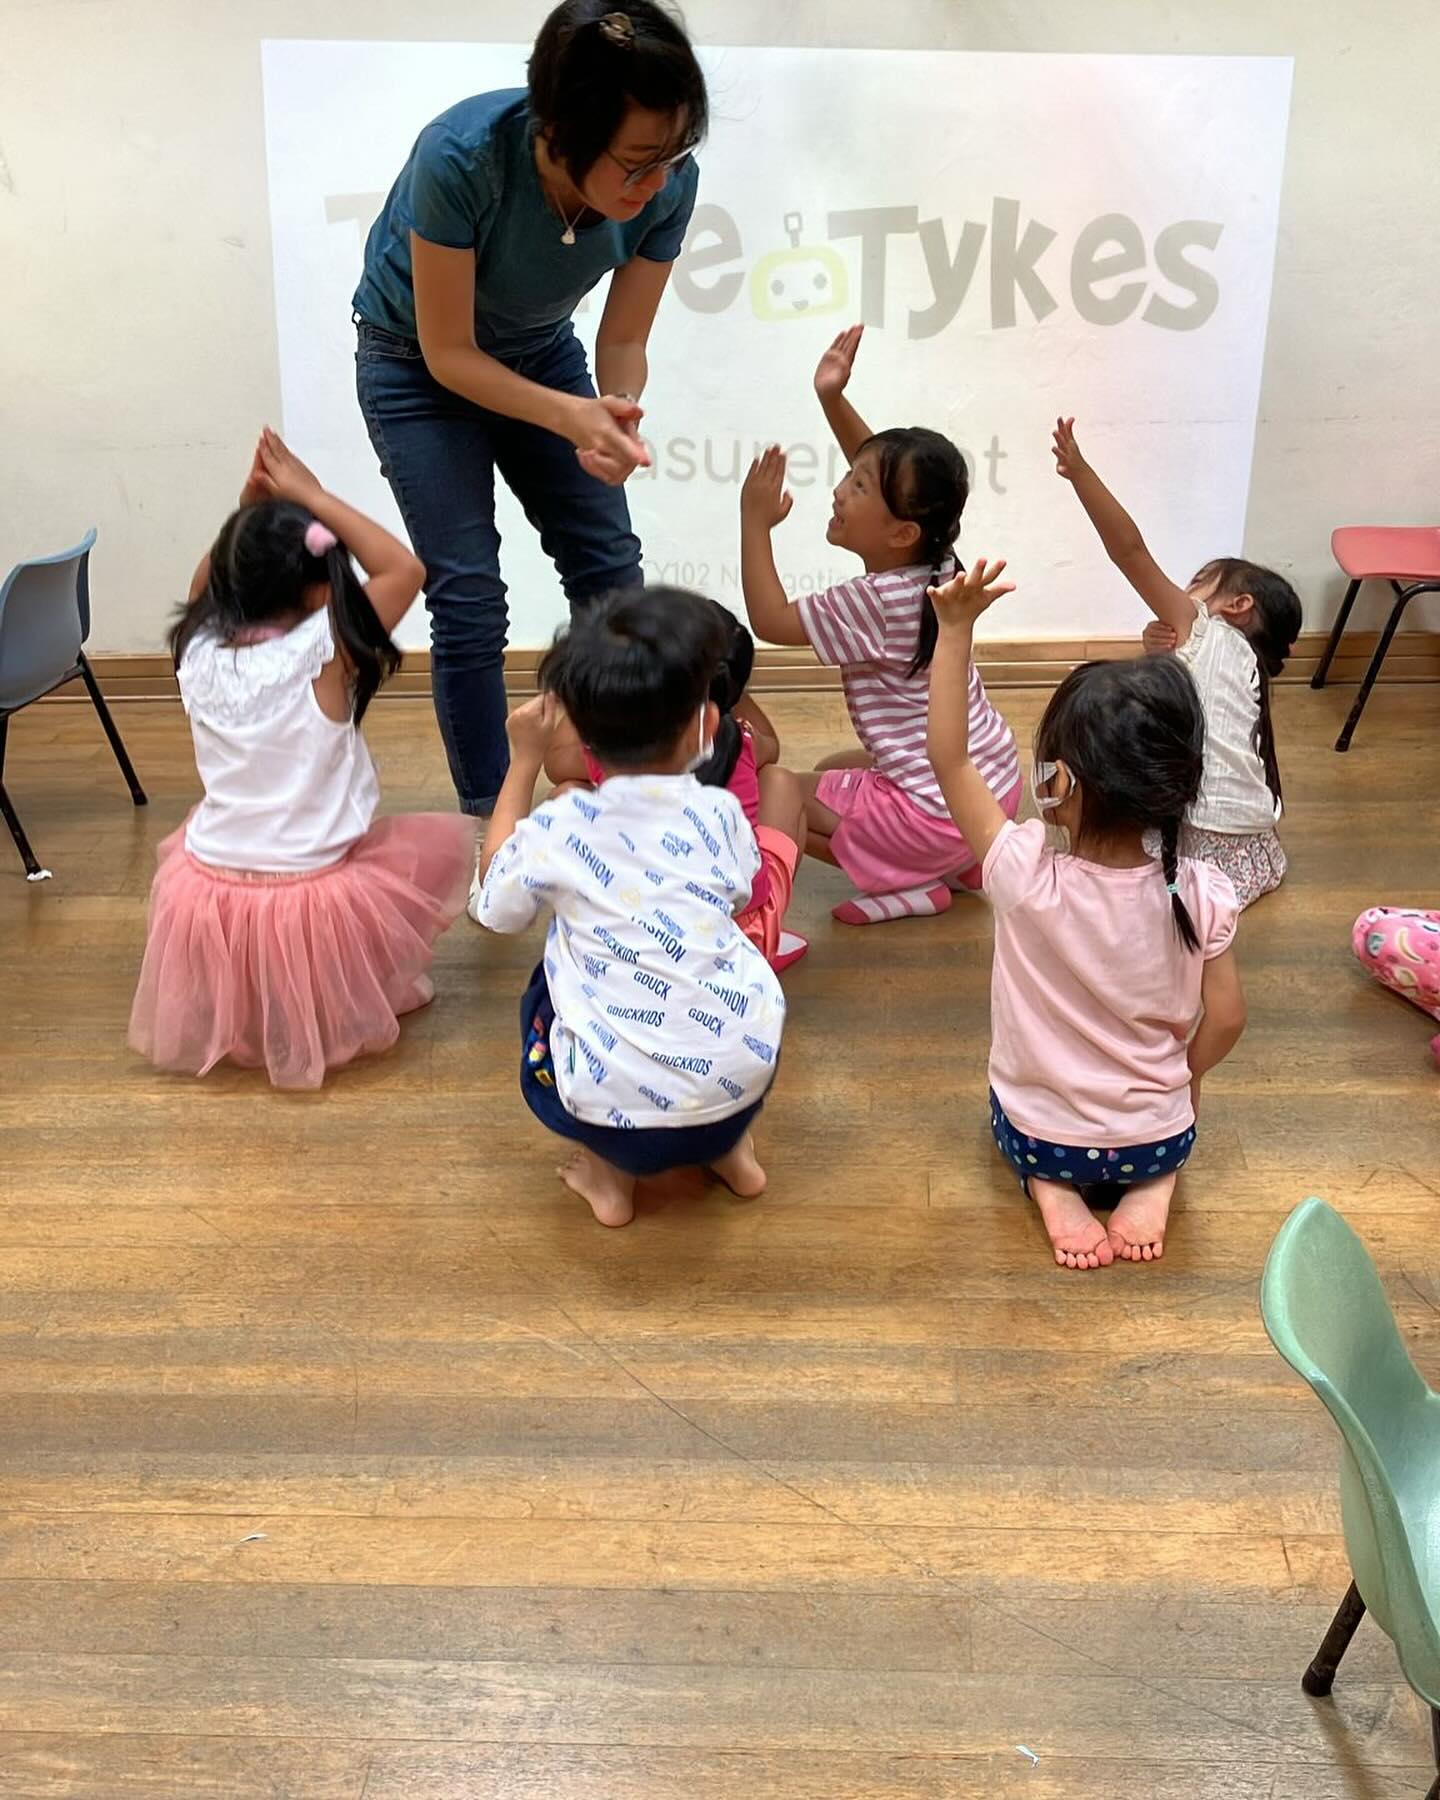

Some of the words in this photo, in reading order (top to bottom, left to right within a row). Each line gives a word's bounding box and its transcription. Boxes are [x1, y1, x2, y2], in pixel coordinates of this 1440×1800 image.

[827, 196, 1224, 340] Tykes
[565, 832, 615, 888] FASHION
[631, 915, 687, 963] SHION
